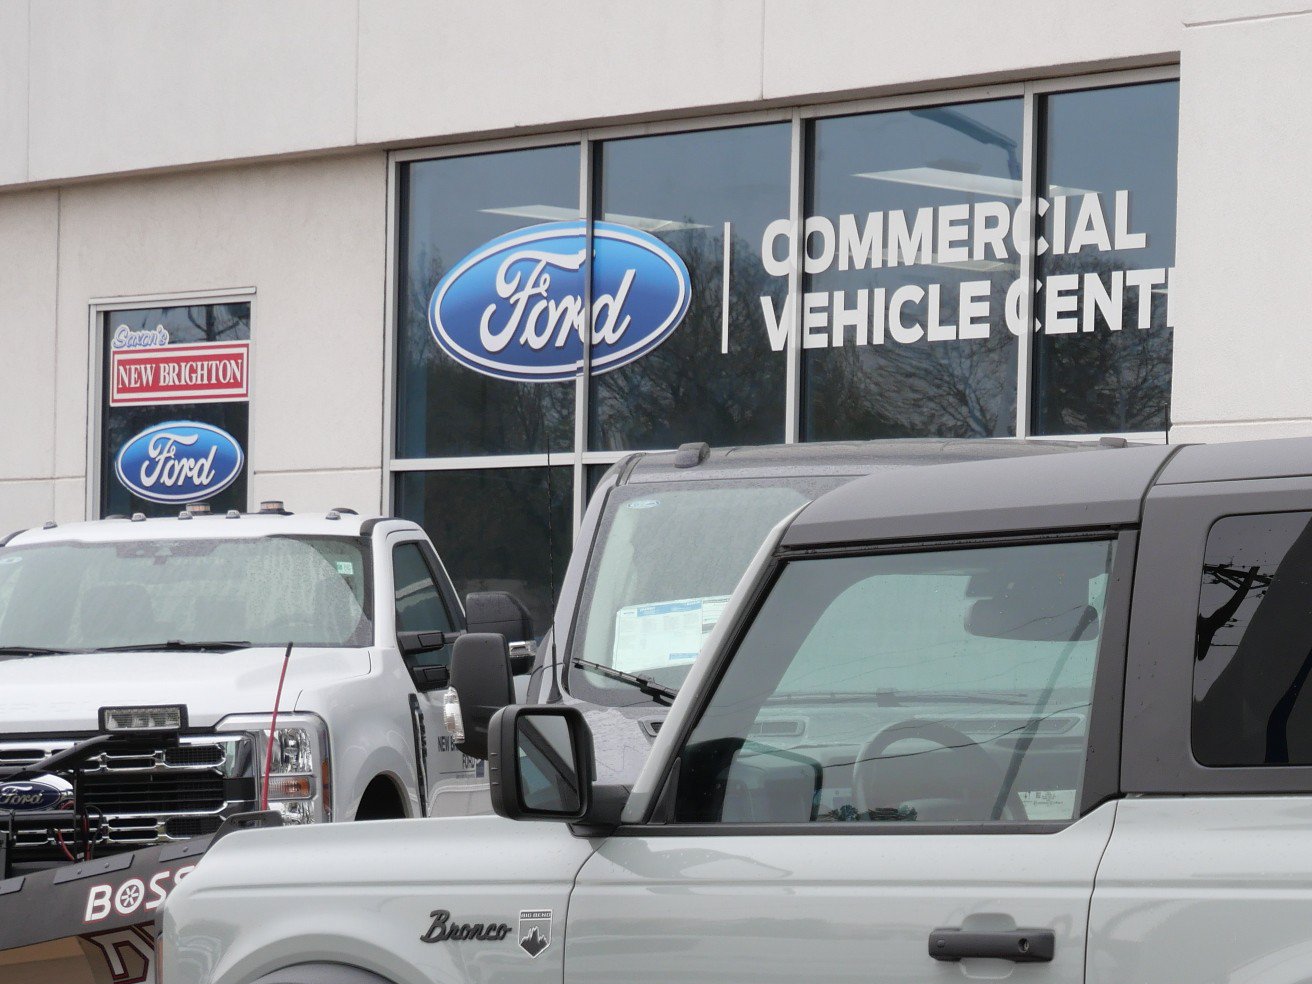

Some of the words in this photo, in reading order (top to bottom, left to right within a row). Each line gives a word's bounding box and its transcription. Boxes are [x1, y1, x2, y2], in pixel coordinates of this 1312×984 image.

[761, 190, 1147, 277] COMMERCIAL
[480, 249, 637, 353] Ford
[760, 280, 991, 352] VEHICLE
[1005, 266, 1175, 336] CENT
[118, 364, 155, 388] NEW
[159, 360, 242, 386] BRIGHTON
[140, 432, 218, 487] Ford
[0, 786, 44, 805] Ford
[420, 909, 512, 943] Bronco
